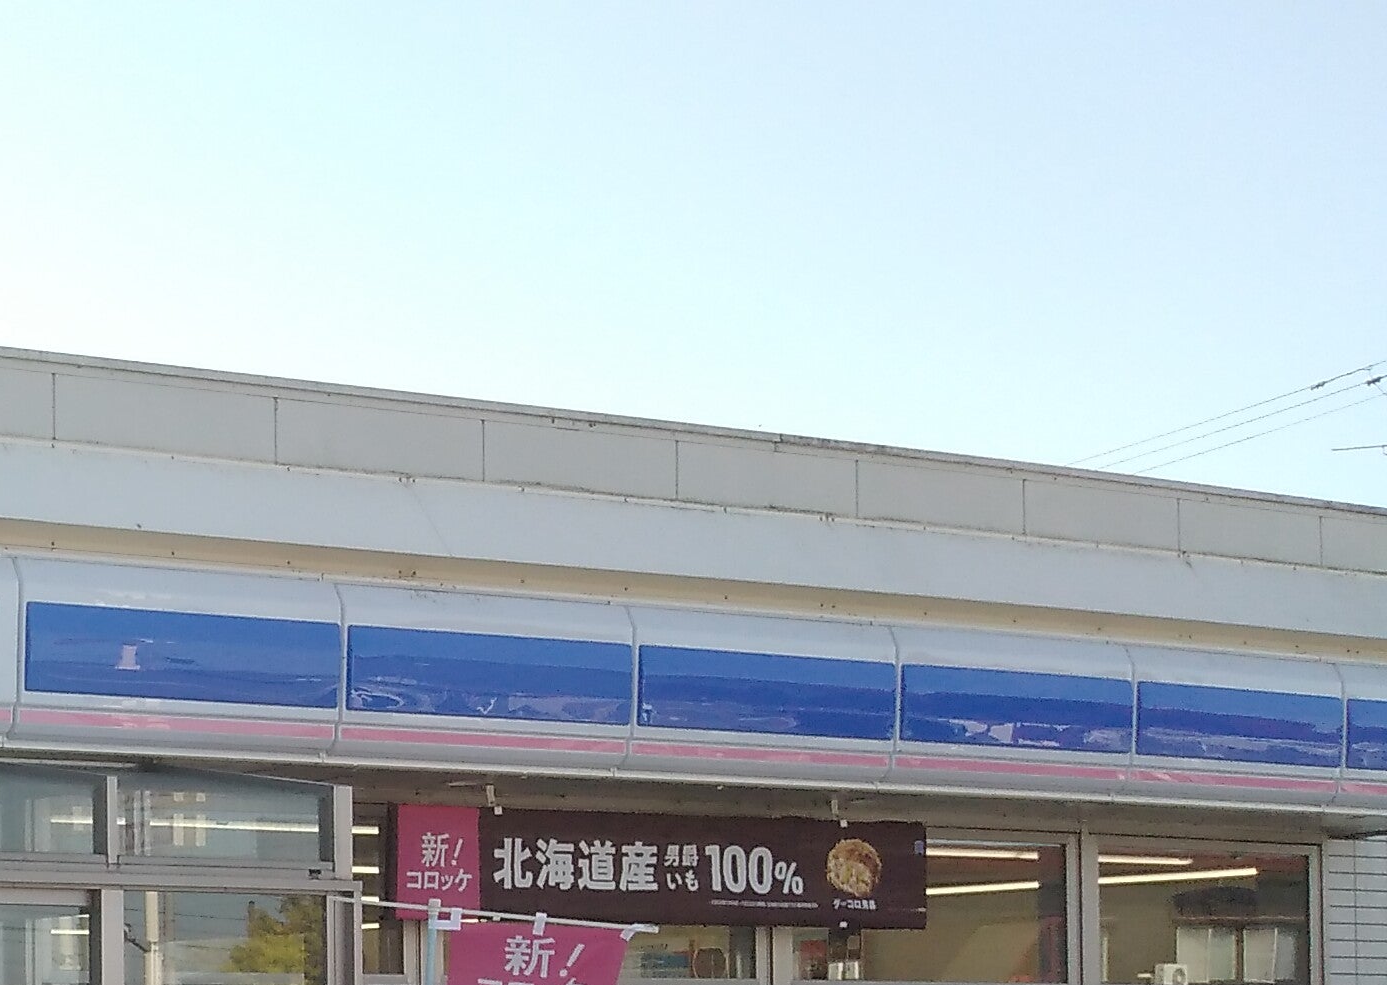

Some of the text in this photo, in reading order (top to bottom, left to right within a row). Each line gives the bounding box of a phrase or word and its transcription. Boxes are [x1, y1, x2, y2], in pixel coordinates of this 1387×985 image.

[421, 832, 464, 868] 新!
[492, 837, 660, 891] 北海道産
[664, 844, 699, 867] 男爵
[406, 868, 473, 892] コロッケ
[666, 870, 699, 891] いも
[705, 844, 804, 895] 100%
[504, 935, 585, 978] 新!
